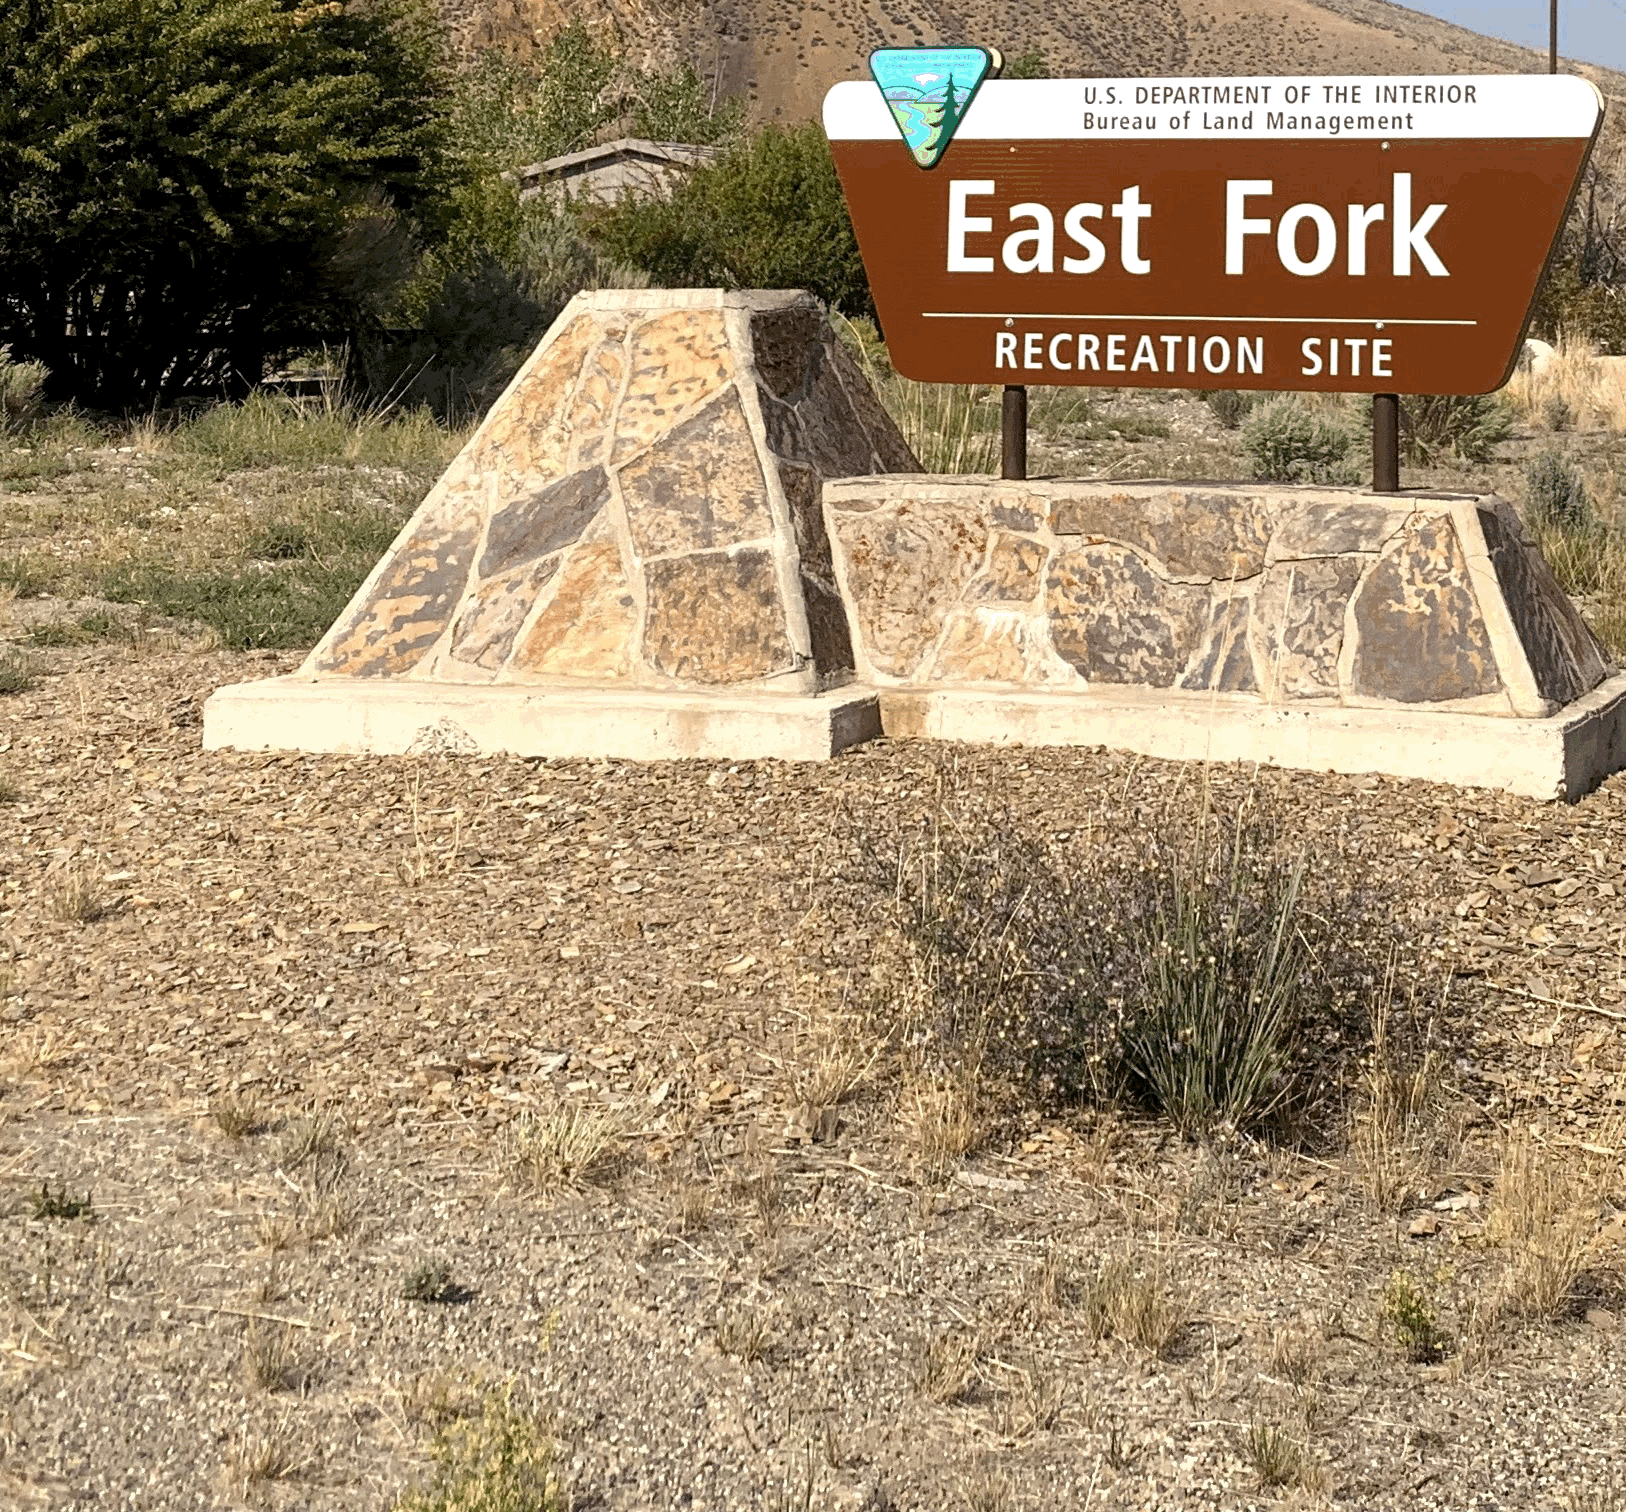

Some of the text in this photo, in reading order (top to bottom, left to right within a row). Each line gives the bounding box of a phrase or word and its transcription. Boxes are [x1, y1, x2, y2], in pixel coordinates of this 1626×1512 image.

[1084, 84, 1477, 105] U.S. DEPARTMENT OF THE INTERIOR
[1083, 111, 1414, 135] Bureau of Land Management
[946, 172, 1450, 277] East Fork
[995, 332, 1394, 378] RECREATION SITE
